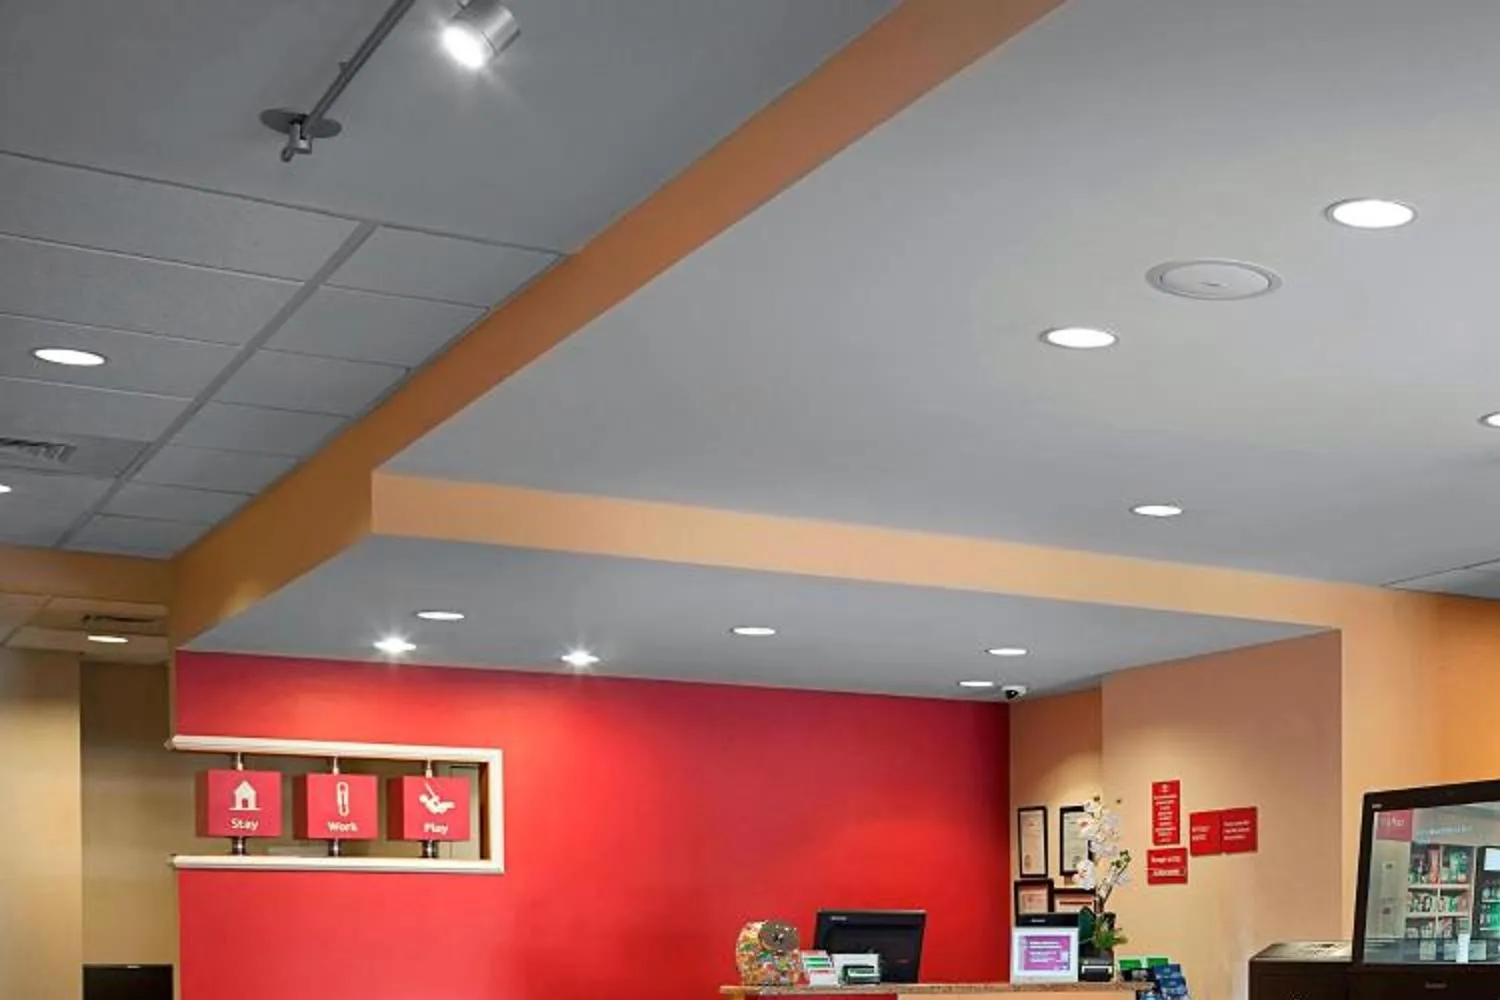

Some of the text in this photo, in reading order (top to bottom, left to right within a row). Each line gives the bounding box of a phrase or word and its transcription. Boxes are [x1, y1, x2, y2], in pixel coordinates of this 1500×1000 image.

[231, 817, 259, 832] Stay
[327, 821, 358, 832] Work
[423, 822, 449, 836] Play
